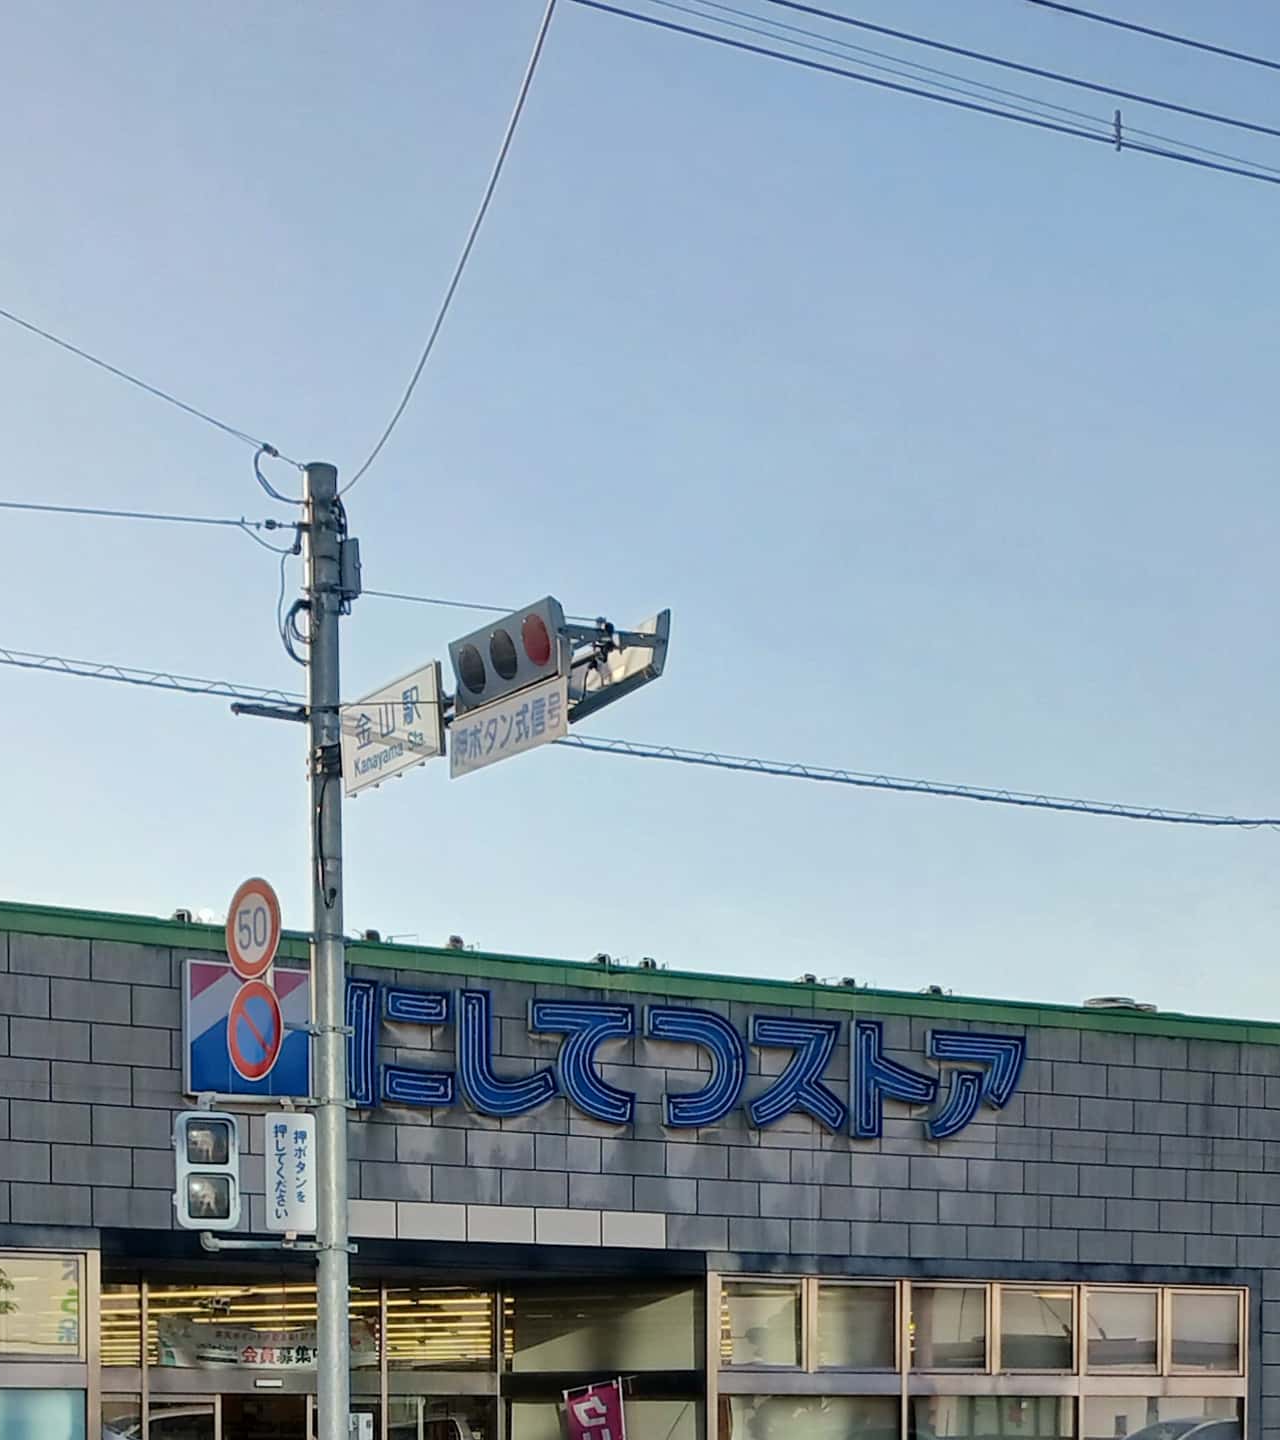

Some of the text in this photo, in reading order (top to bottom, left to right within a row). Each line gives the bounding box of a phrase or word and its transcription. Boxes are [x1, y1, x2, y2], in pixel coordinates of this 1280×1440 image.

[354, 730, 426, 777] Kanayama Sta.
[356, 685, 422, 751] 金山駅
[453, 691, 562, 767] 押ボタン式信号
[238, 906, 267, 950] 50
[345, 979, 1027, 1139] にしてつストア
[273, 1123, 289, 1219] 押してください
[293, 1130, 308, 1203] 押ボタンを
